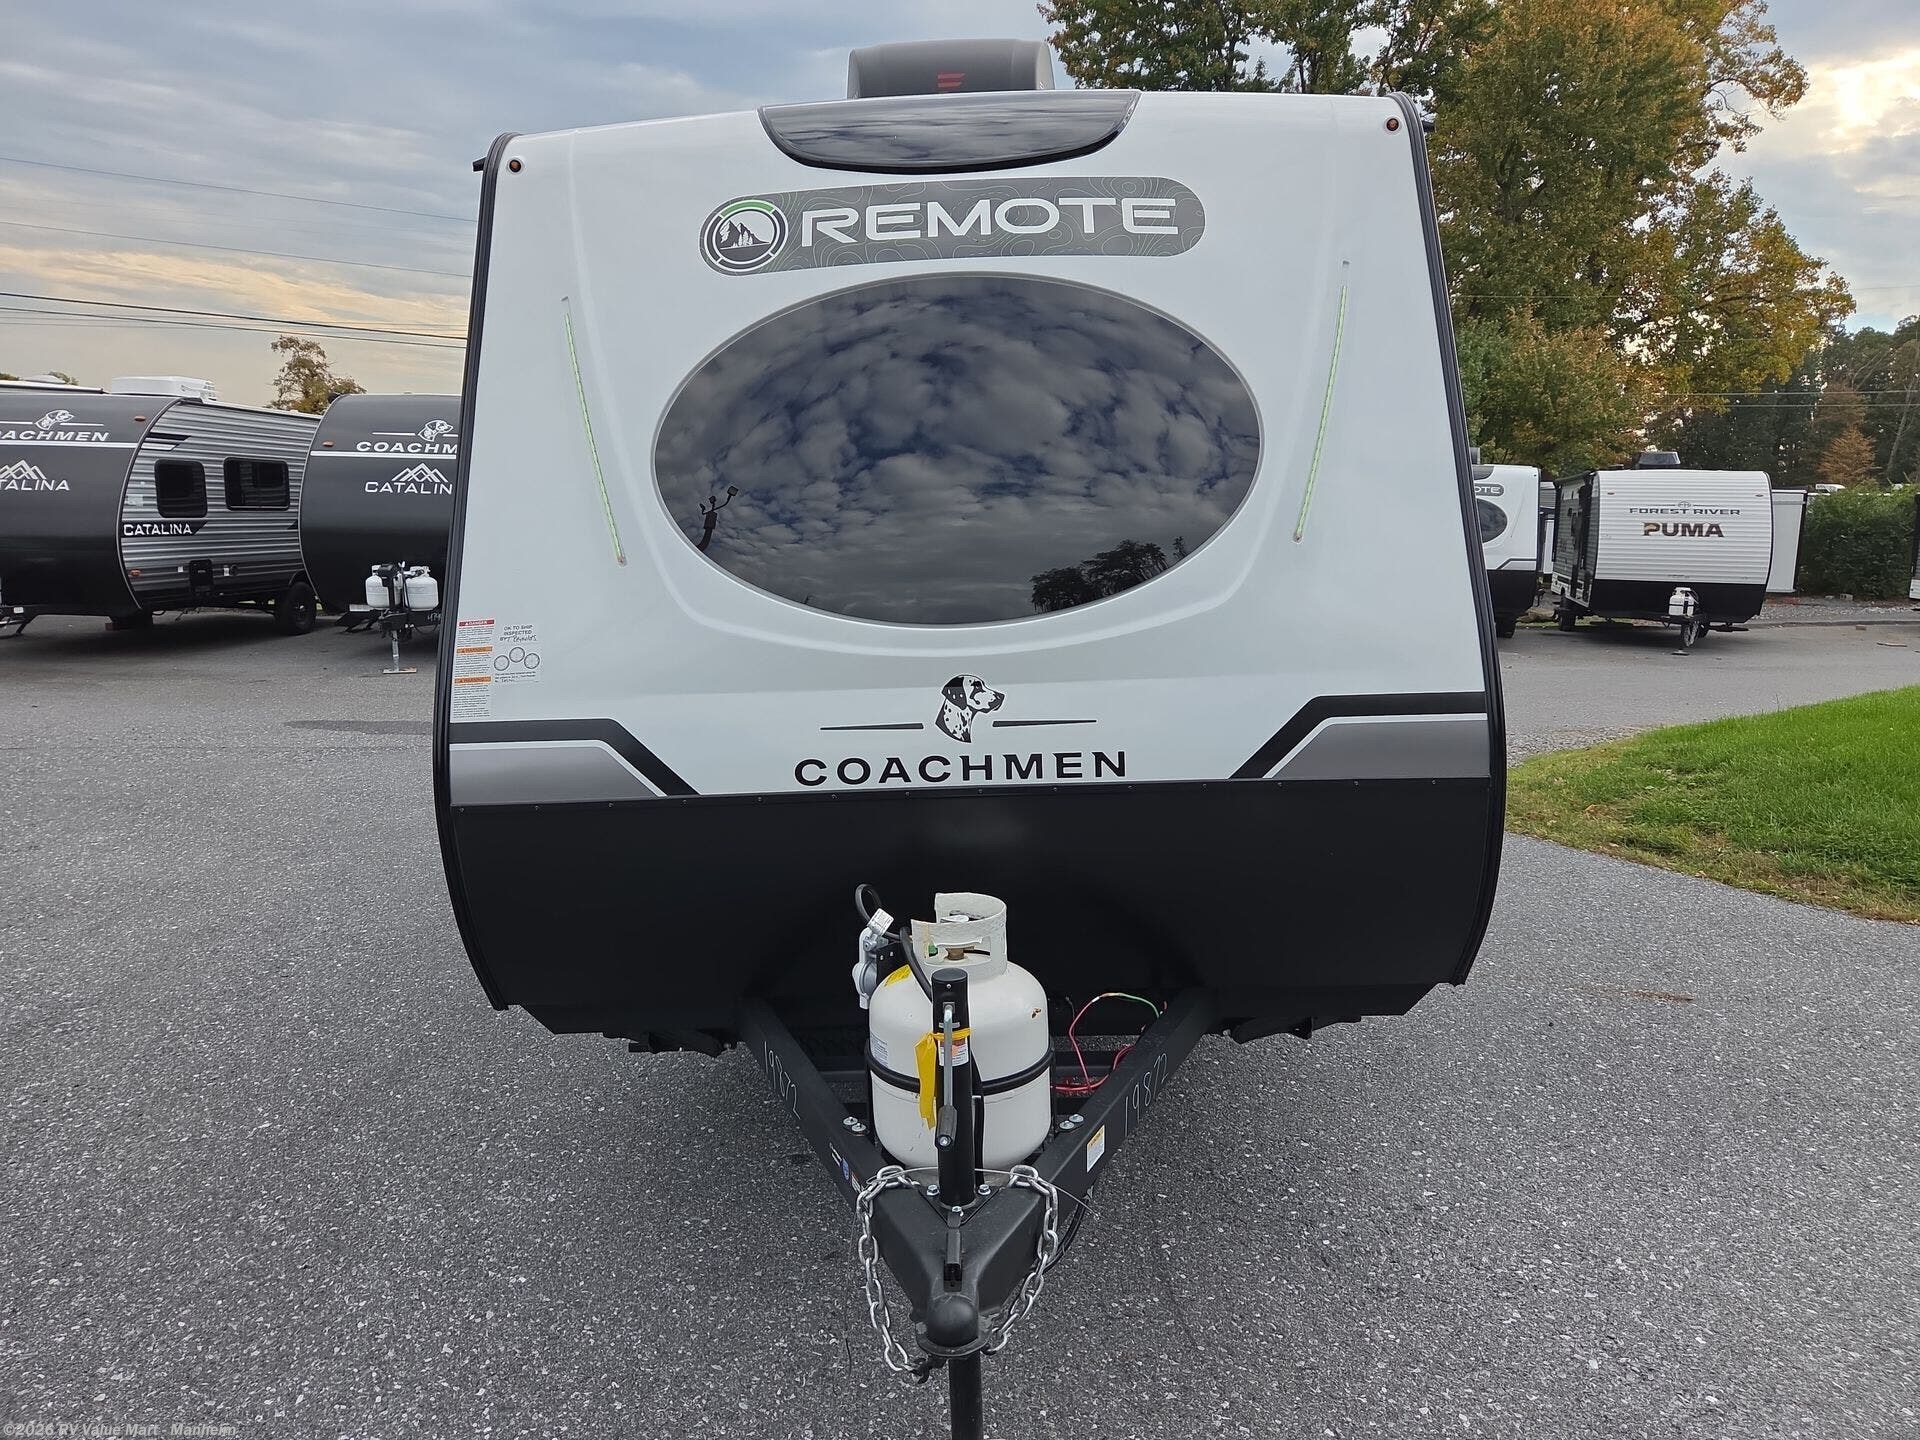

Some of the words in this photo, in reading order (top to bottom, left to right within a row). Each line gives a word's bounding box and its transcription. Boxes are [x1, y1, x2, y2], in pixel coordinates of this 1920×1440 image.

[802, 197, 1178, 247] REMOTE
[0, 430, 110, 442] ACHMEN
[364, 481, 453, 495] CATALIN
[1629, 507, 1690, 515] FOREST
[1693, 508, 1741, 516] RIVER
[123, 523, 193, 536] CATALINA
[1641, 522, 1725, 538] PUMA
[794, 750, 1126, 786] COACHMEN
